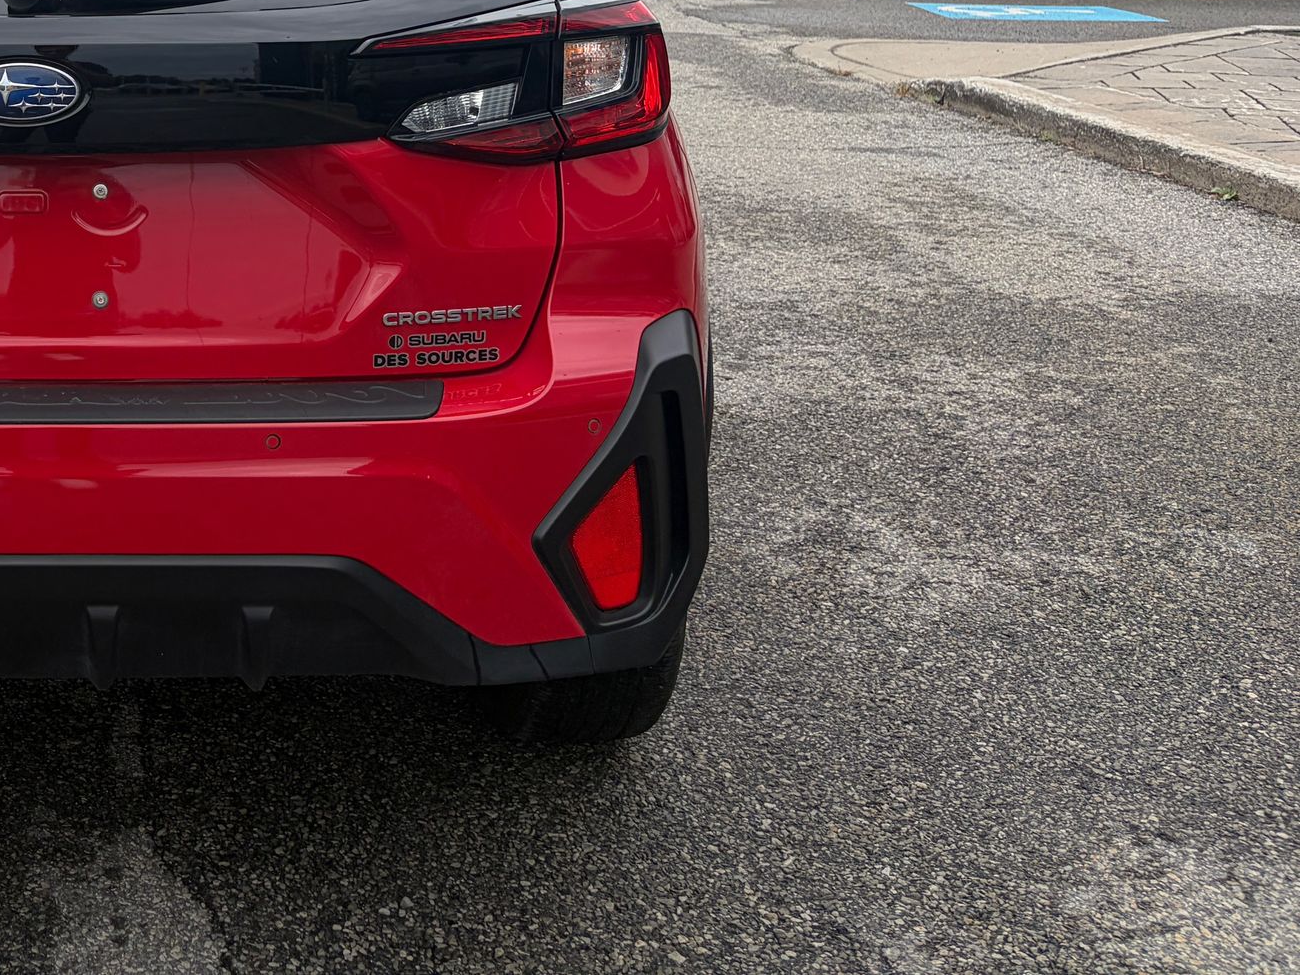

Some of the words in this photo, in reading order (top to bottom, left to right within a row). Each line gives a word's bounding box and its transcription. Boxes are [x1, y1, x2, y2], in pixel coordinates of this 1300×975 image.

[382, 304, 523, 327] CROSSTREK
[408, 331, 486, 347] SUBARU
[373, 353, 408, 368] DES
[416, 348, 499, 366] SOURCES
